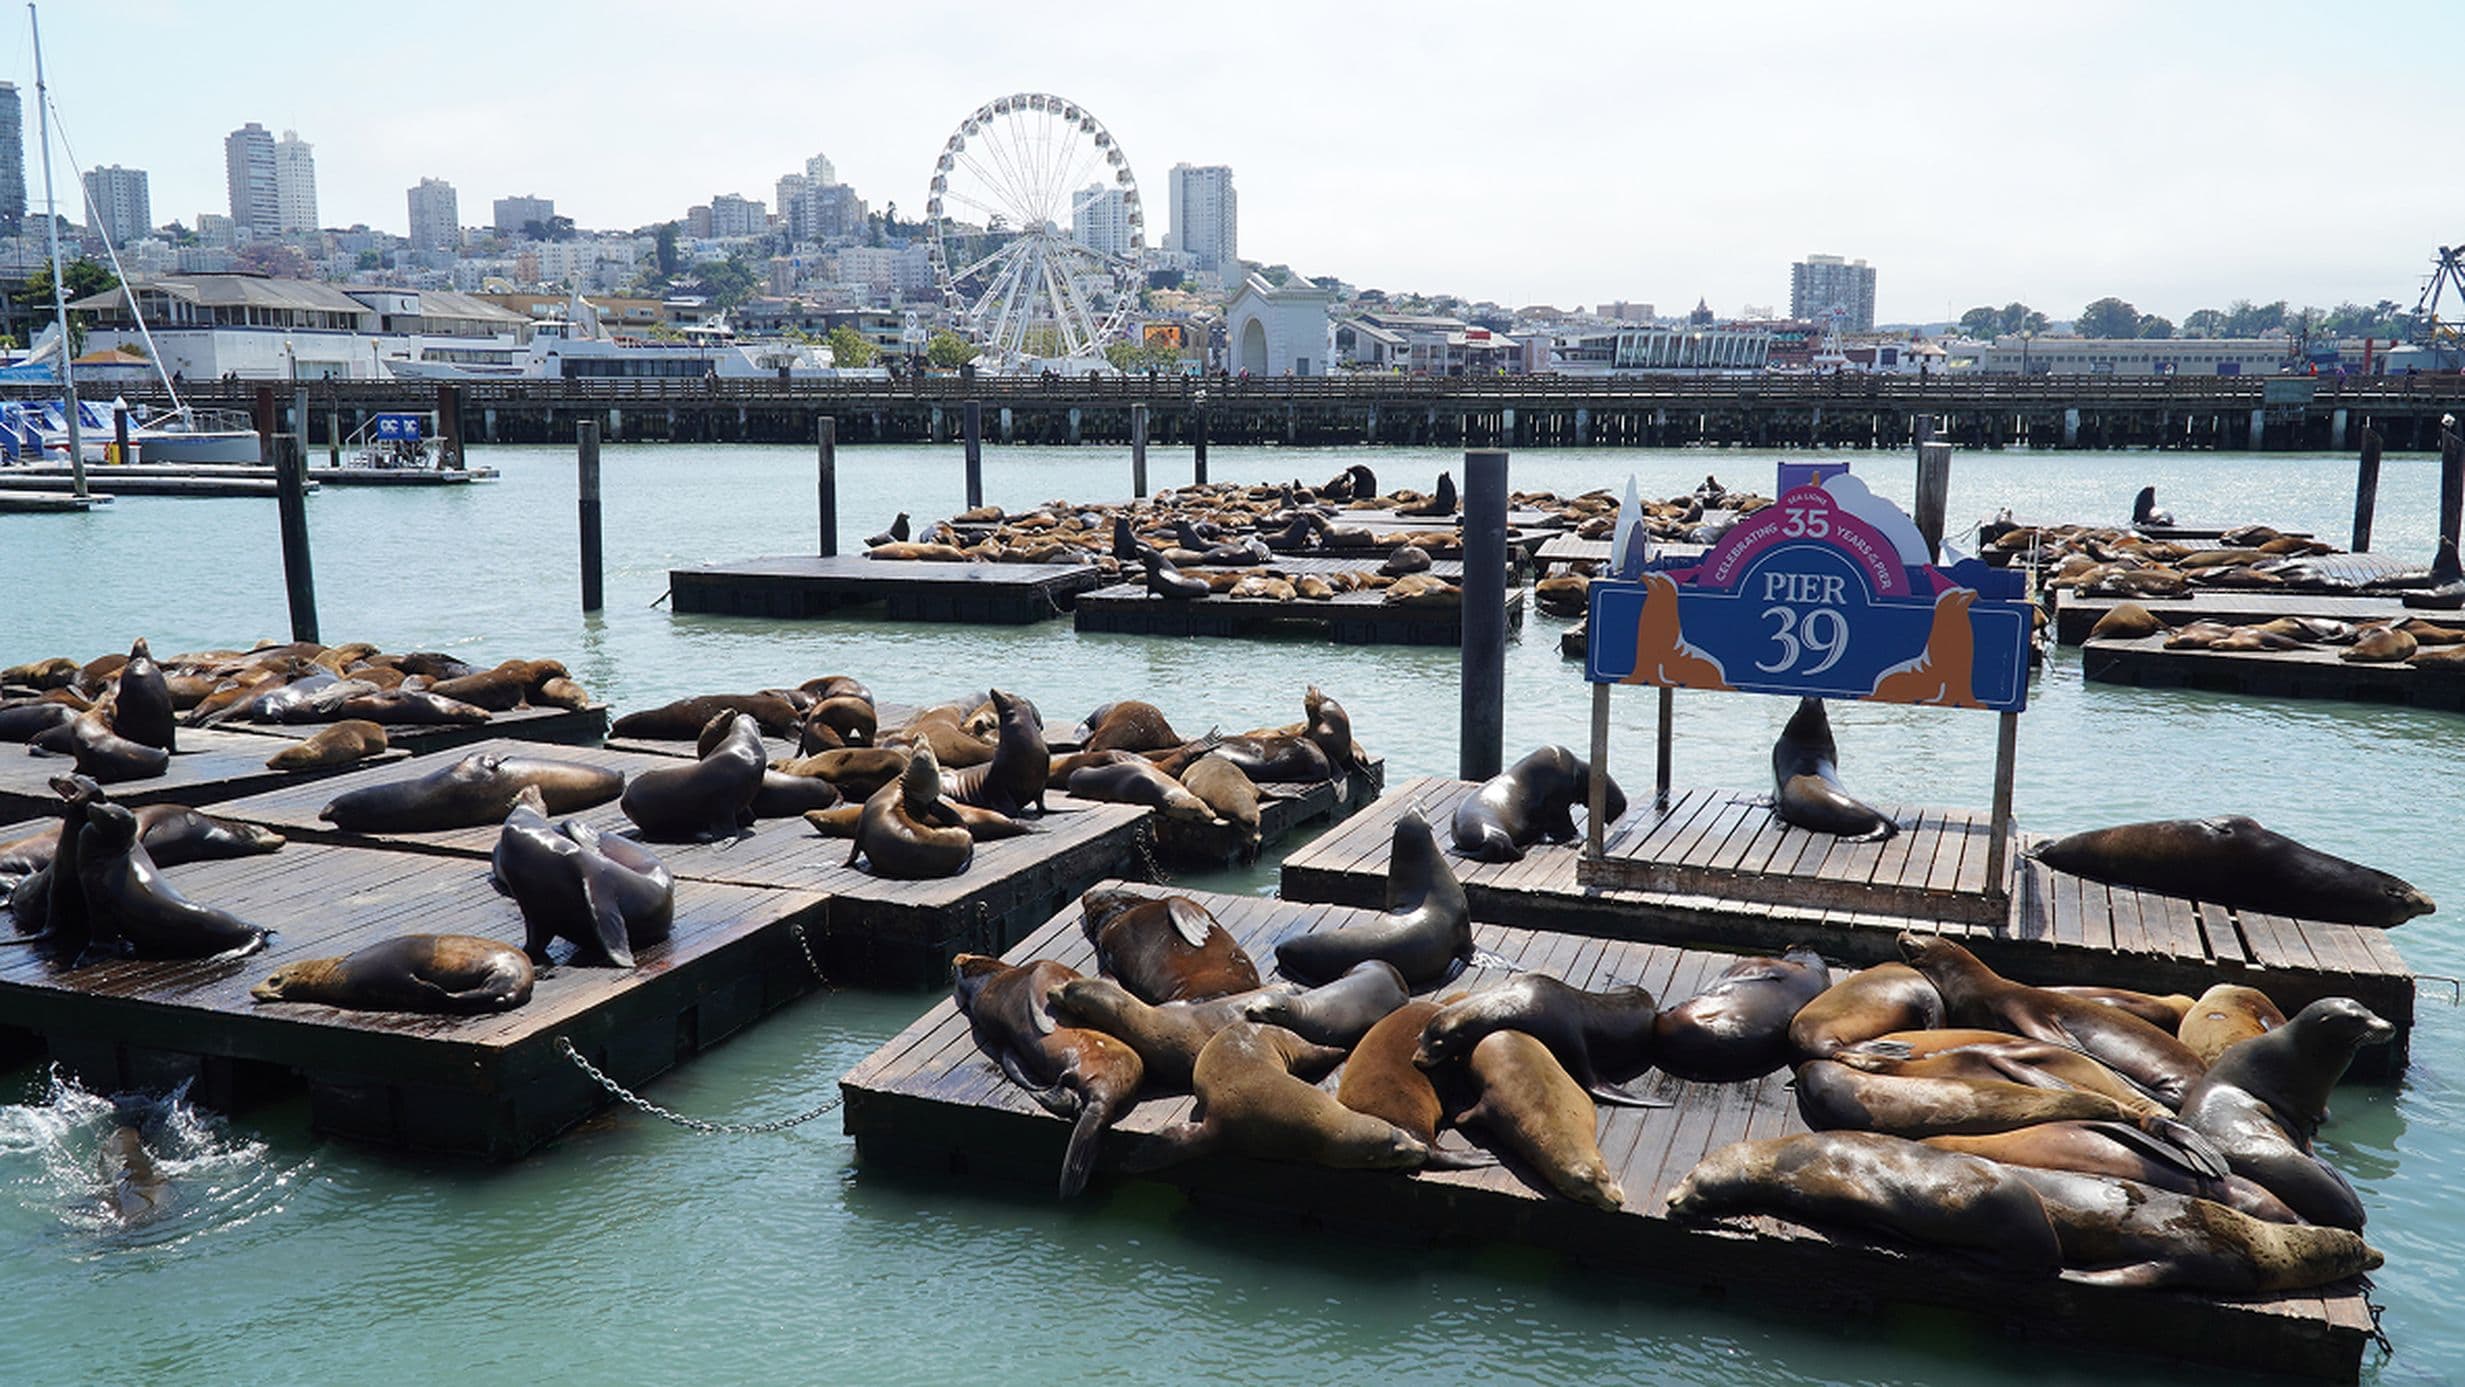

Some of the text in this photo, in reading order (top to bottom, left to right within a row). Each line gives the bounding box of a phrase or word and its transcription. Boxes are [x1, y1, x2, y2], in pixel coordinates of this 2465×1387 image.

[1715, 522, 1778, 581] CELEBRATING
[1782, 508, 1830, 538] 35
[1837, 525, 1872, 555] YEARS
[1873, 561, 1893, 590] PIER
[1762, 571, 1847, 605] PIER
[1755, 606, 1849, 675] 39
